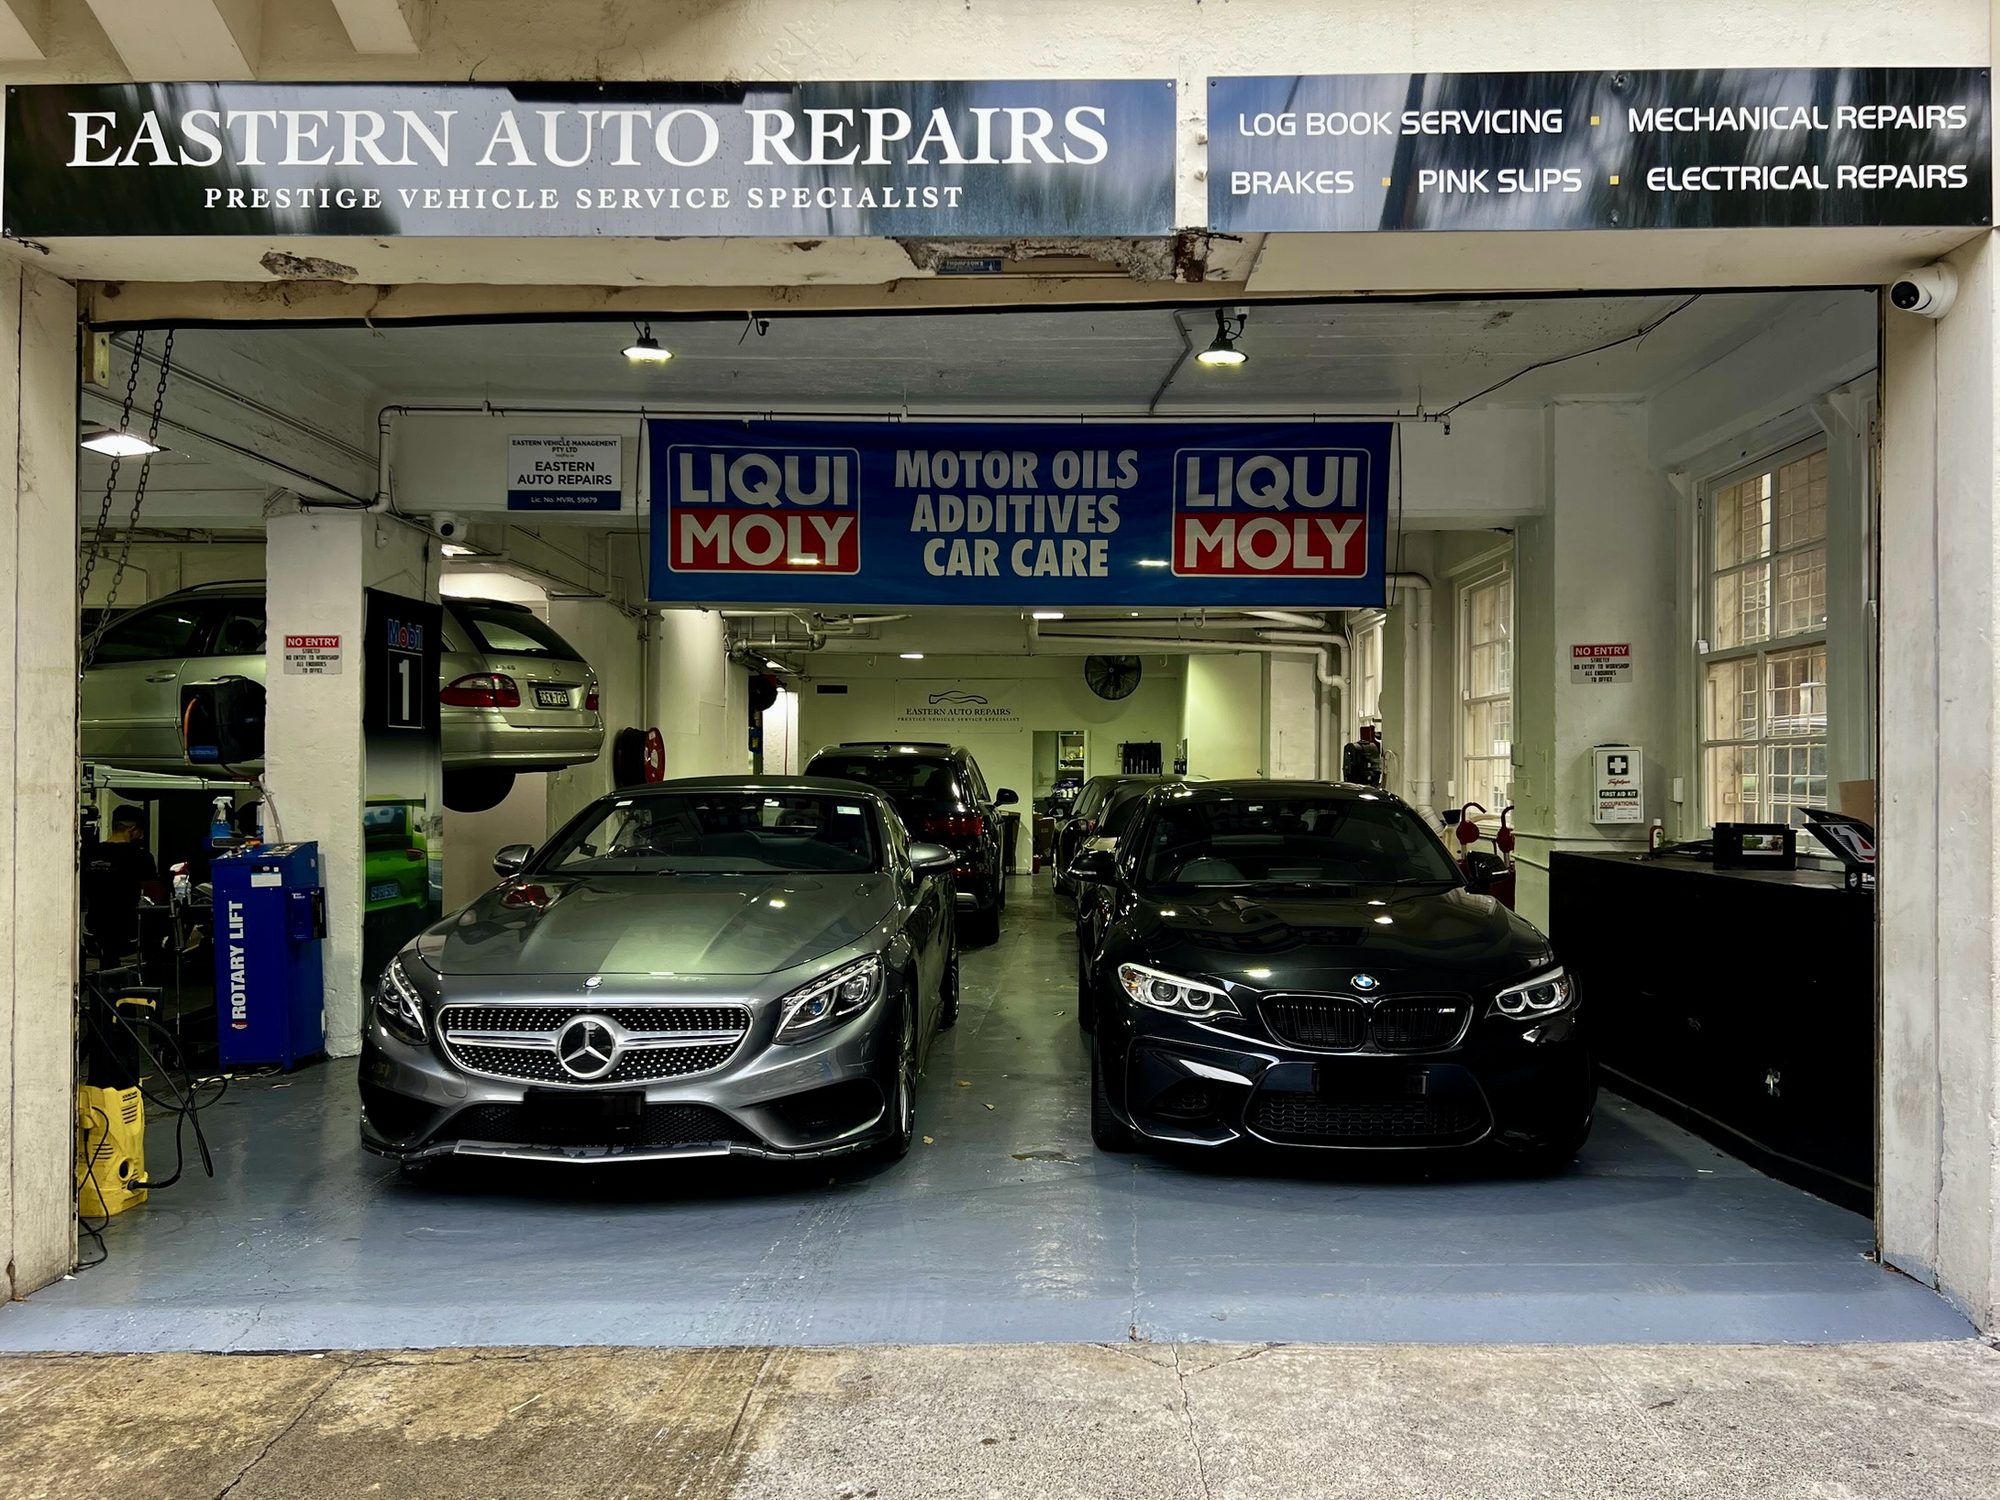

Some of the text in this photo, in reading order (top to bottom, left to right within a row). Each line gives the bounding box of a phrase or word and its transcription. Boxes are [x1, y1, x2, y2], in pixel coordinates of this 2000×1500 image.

[66, 106, 1109, 168] EASTERN AUTO REPAIRS
[1238, 104, 1967, 137] LOG BOOK SERVICING MECHANICAL REPAIRS
[203, 185, 964, 210] PRESTIGE VEHICLE SERVICE SPECIALIST
[1230, 164, 1968, 195] BRAKES PINK SLIPS ELECTRICAL REPAIRS
[517, 474, 612, 485] AUTO REPAIRS
[535, 461, 595, 472] EASTERN
[679, 452, 849, 509] LIQUI
[895, 449, 1139, 490] MOTOR OILS
[1186, 455, 1359, 512] LIQUI
[910, 494, 1121, 533] ADDITIVES
[680, 514, 855, 567] MOLY
[923, 538, 1109, 577] CAR CARE
[1184, 517, 1363, 570] MOLY
[287, 637, 338, 647] NO ENTRY
[387, 618, 423, 651] Mobil
[1575, 645, 1627, 656] NO ENTRY
[399, 658, 411, 721] 1
[906, 708, 1011, 716] EASTERN AUTO REPAIRS
[228, 900, 247, 1020] ROTARY LIFT
